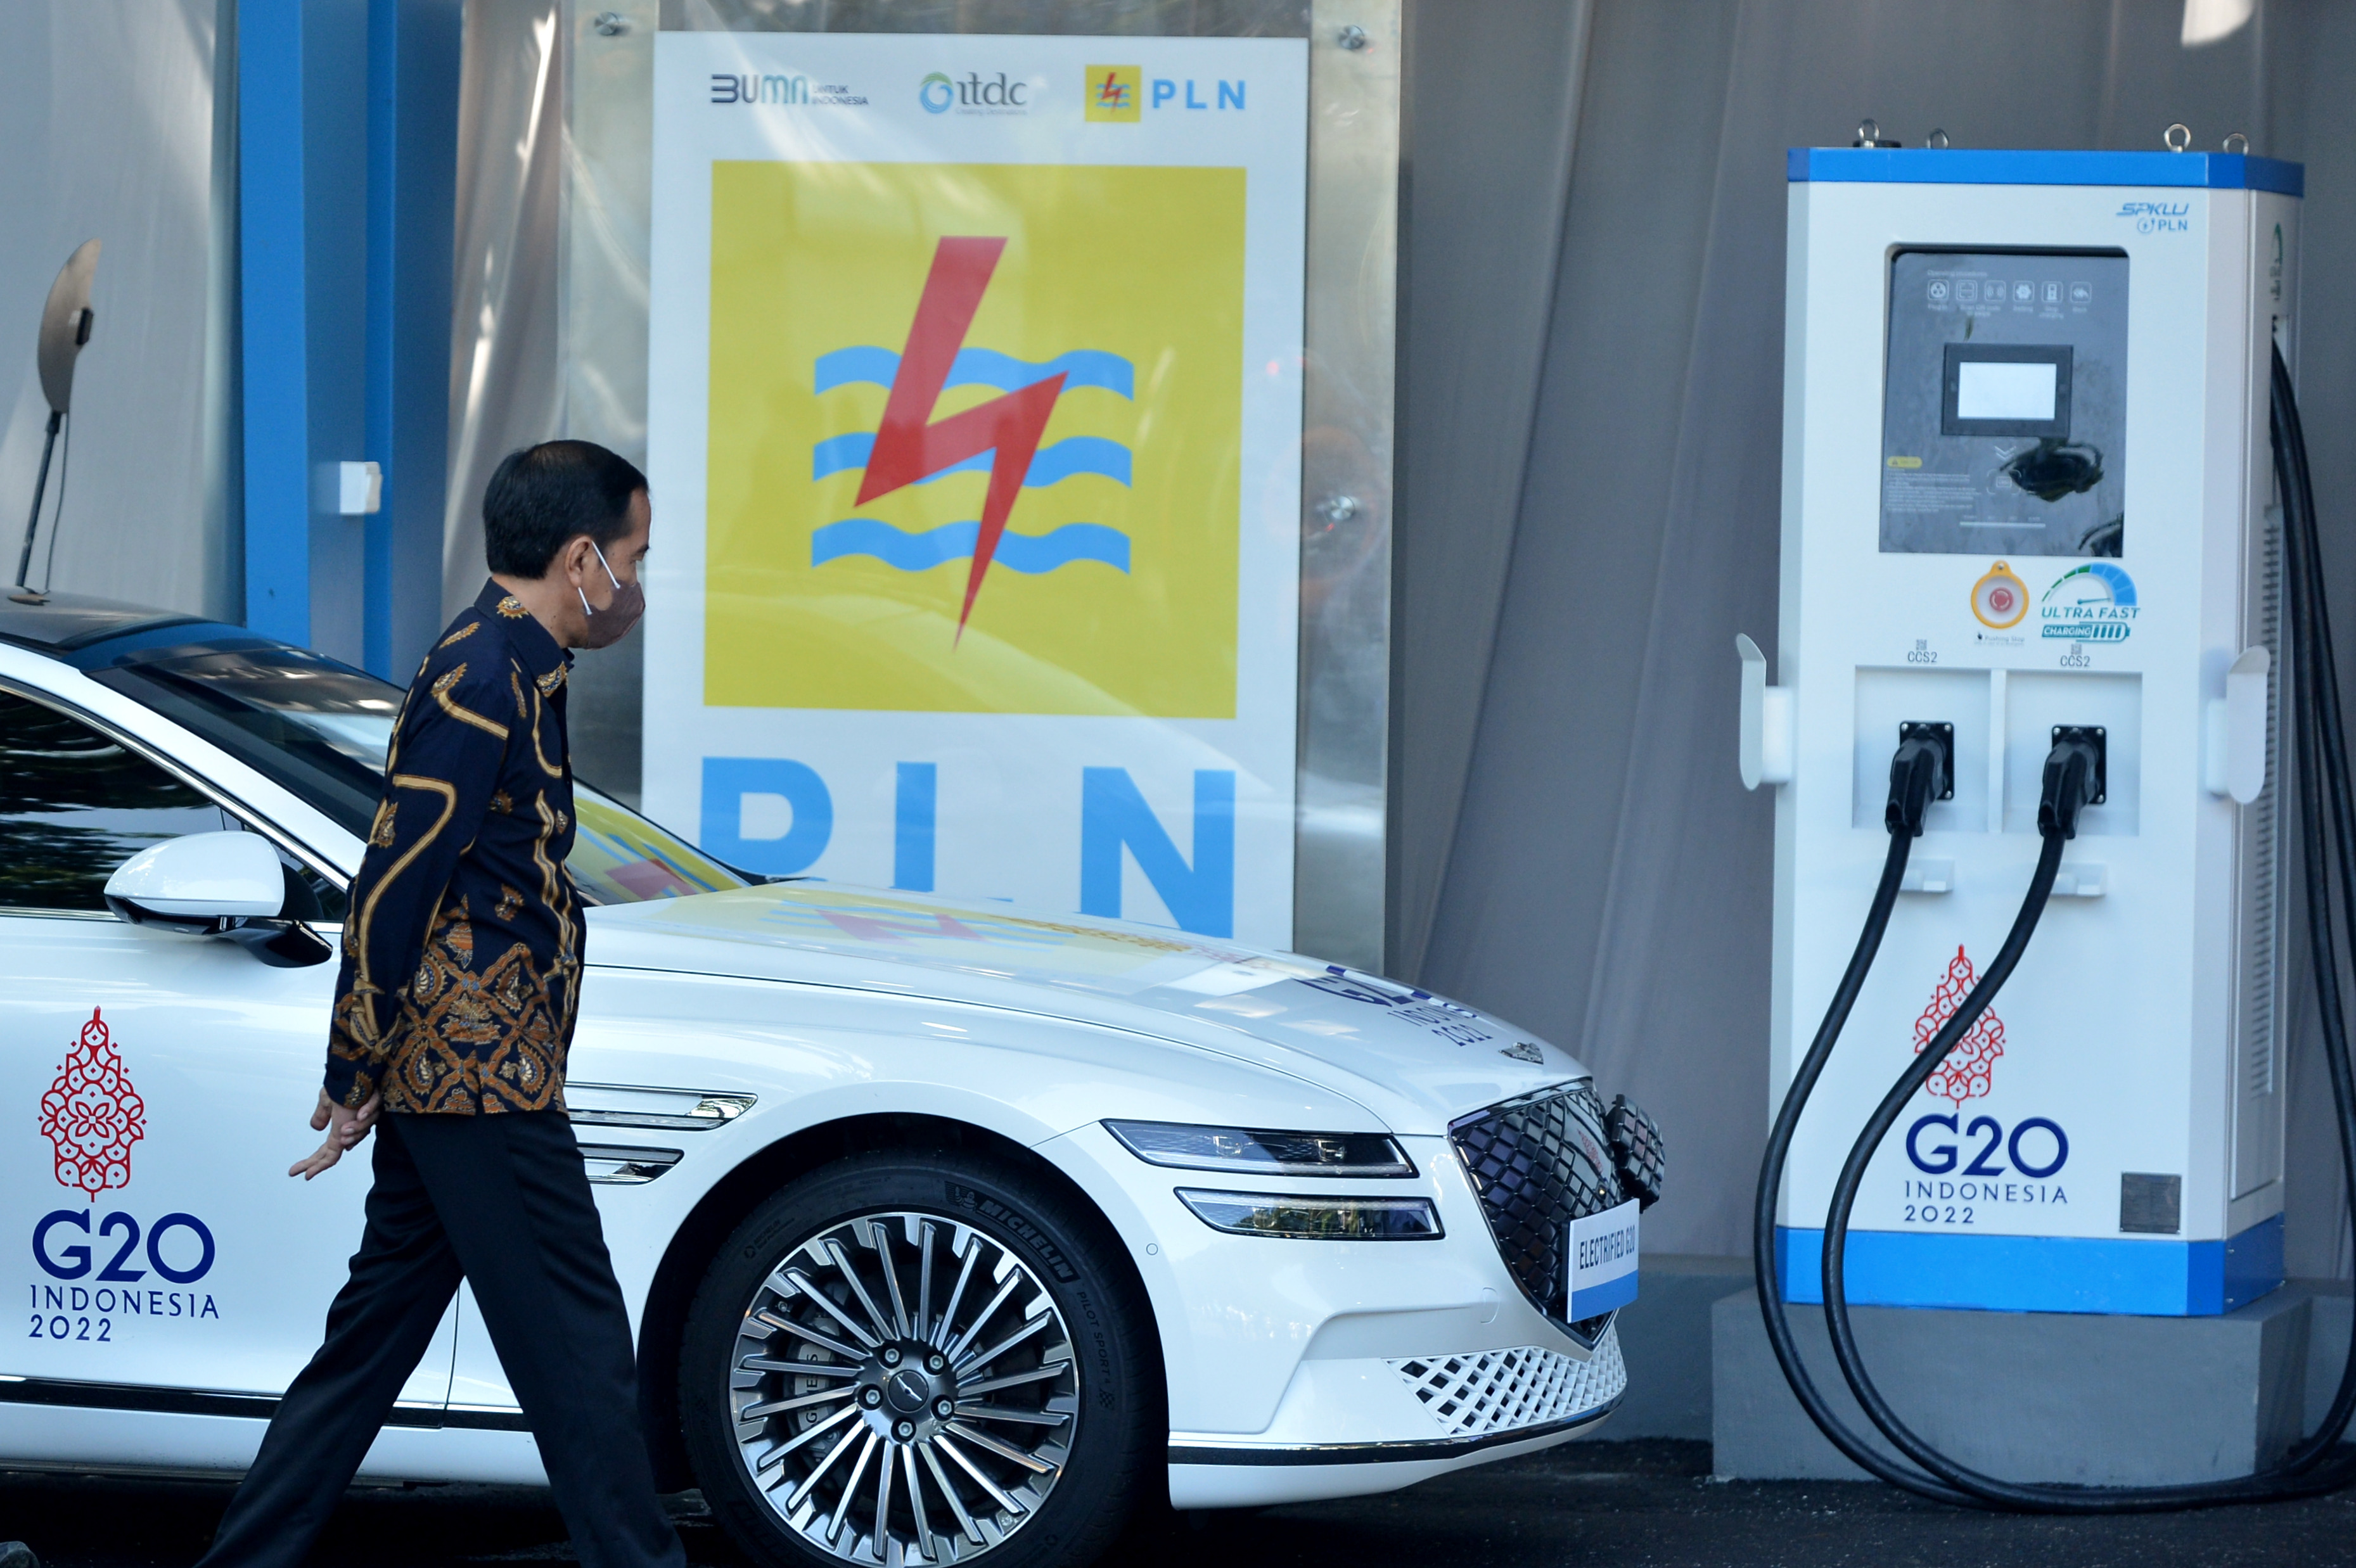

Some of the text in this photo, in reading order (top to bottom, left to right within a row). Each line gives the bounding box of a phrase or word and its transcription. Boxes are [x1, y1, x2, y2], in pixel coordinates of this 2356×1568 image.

[812, 96, 869, 105] INDONESIA
[1151, 79, 1246, 110] PLN
[2158, 219, 2188, 231] PLN
[2041, 606, 2141, 619] ULTRA FAST
[2044, 627, 2091, 635] CHARGING
[1907, 651, 1937, 664] CCS2
[2060, 655, 2090, 668] CCS2
[1905, 1112, 2069, 1178] G20
[1905, 1180, 2068, 1204] INDONESIA
[1905, 1206, 1974, 1224] 2022
[32, 1208, 215, 1284] G20
[979, 1199, 1075, 1280] MICHELIN
[1579, 1229, 1625, 1270] ELECTRIFIED
[30, 1284, 219, 1320] INDONESIA
[29, 1314, 112, 1342] 2022
[1077, 1291, 1099, 1329] PILOT
[1094, 1331, 1111, 1376] SPORT
